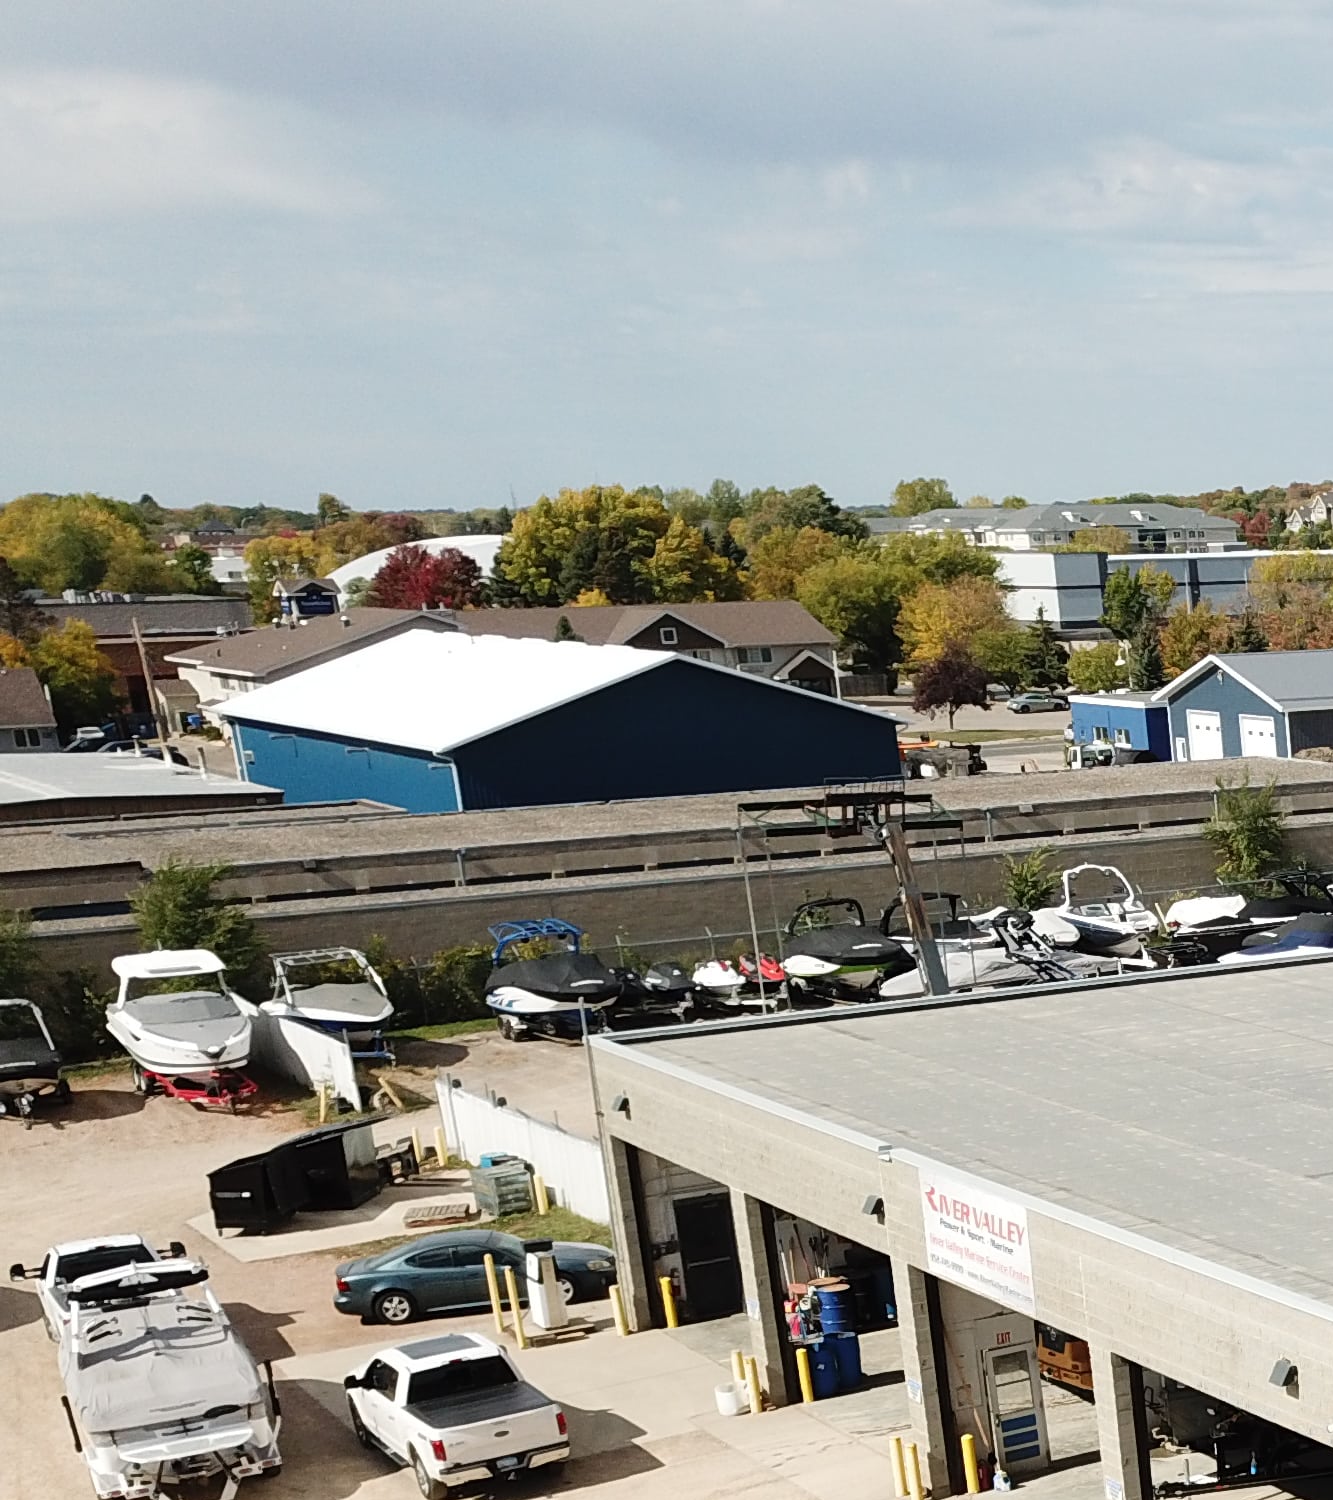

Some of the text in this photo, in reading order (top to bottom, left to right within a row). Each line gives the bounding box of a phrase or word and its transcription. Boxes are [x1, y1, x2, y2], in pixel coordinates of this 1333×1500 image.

[925, 1185, 1025, 1246] RIVER VALLEY
[996, 1331, 1011, 1345] EXIT
